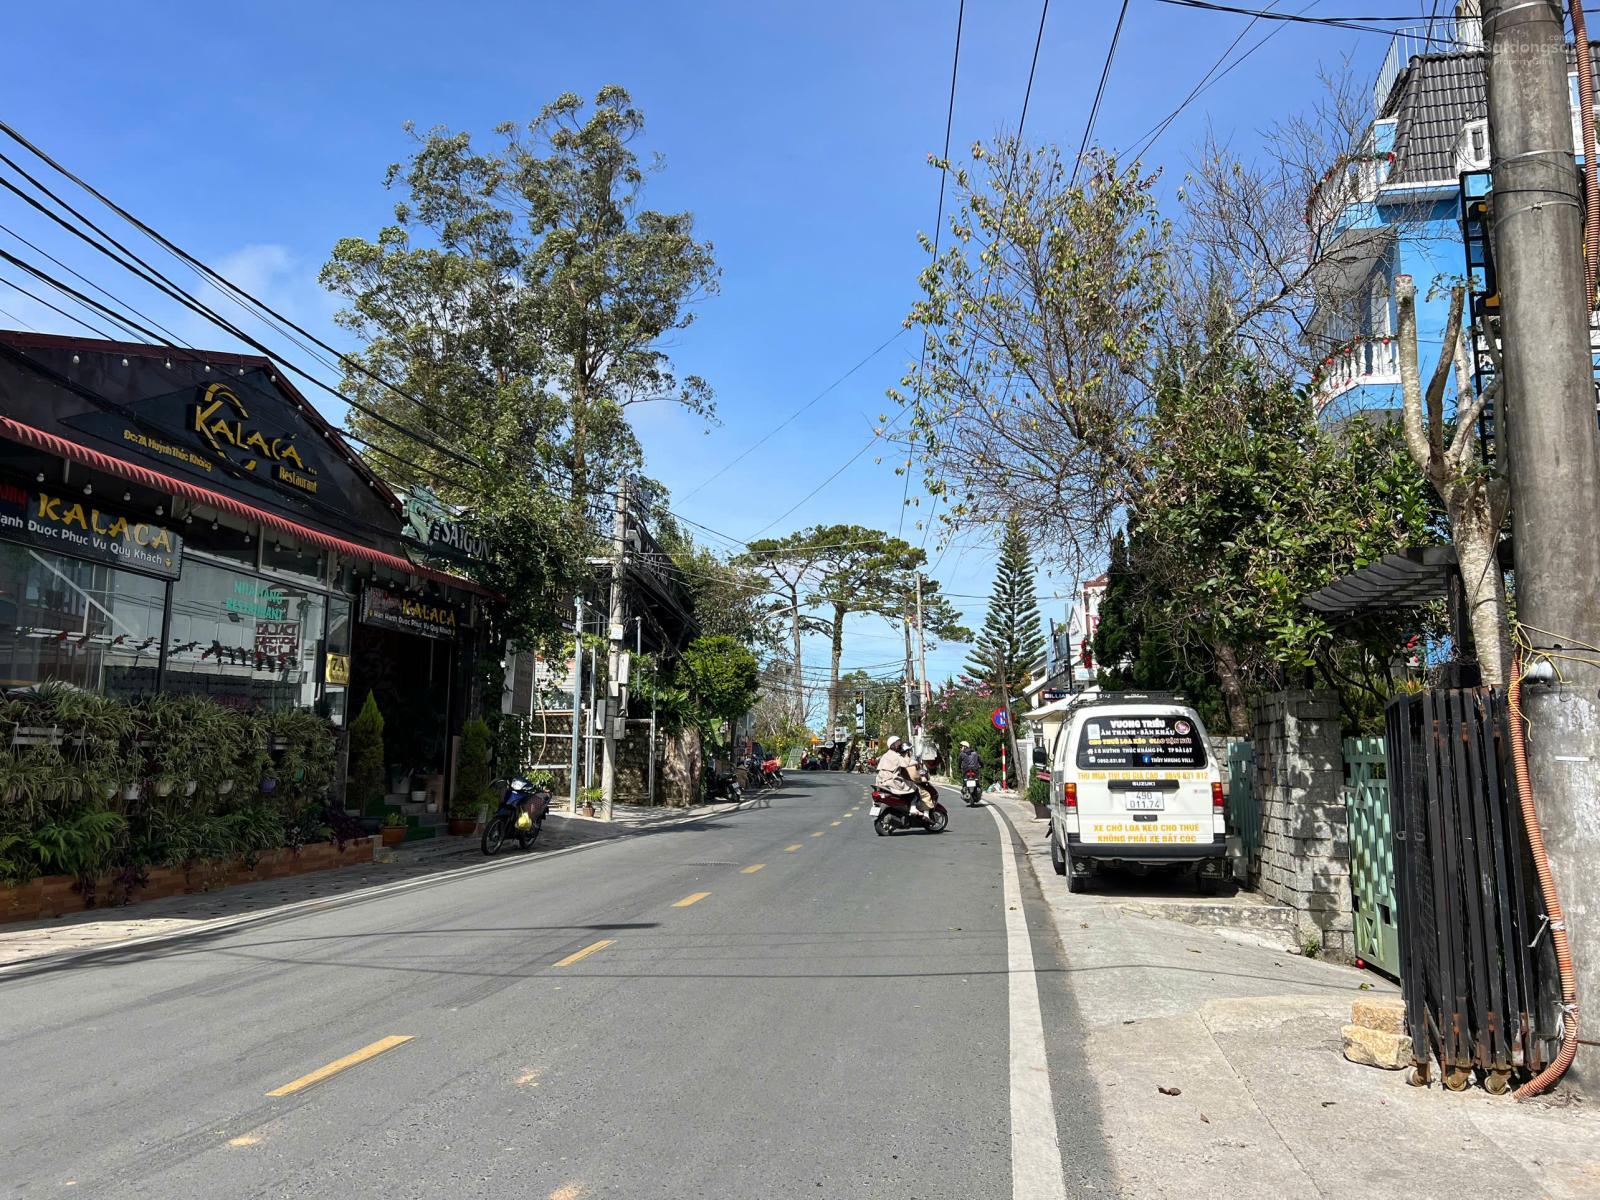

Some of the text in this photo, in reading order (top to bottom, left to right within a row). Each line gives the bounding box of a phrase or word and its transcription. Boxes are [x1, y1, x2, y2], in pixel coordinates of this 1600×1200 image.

[279, 465, 317, 494] Restaurant
[0, 513, 24, 529] ạnh
[61, 529, 89, 547] Phục
[92, 537, 107, 551] Vụ
[331, 657, 345, 672] 7A
[1130, 800, 1160, 809] 011.74
[1093, 824, 1104, 832] XE
[1125, 824, 1140, 832] LOA
